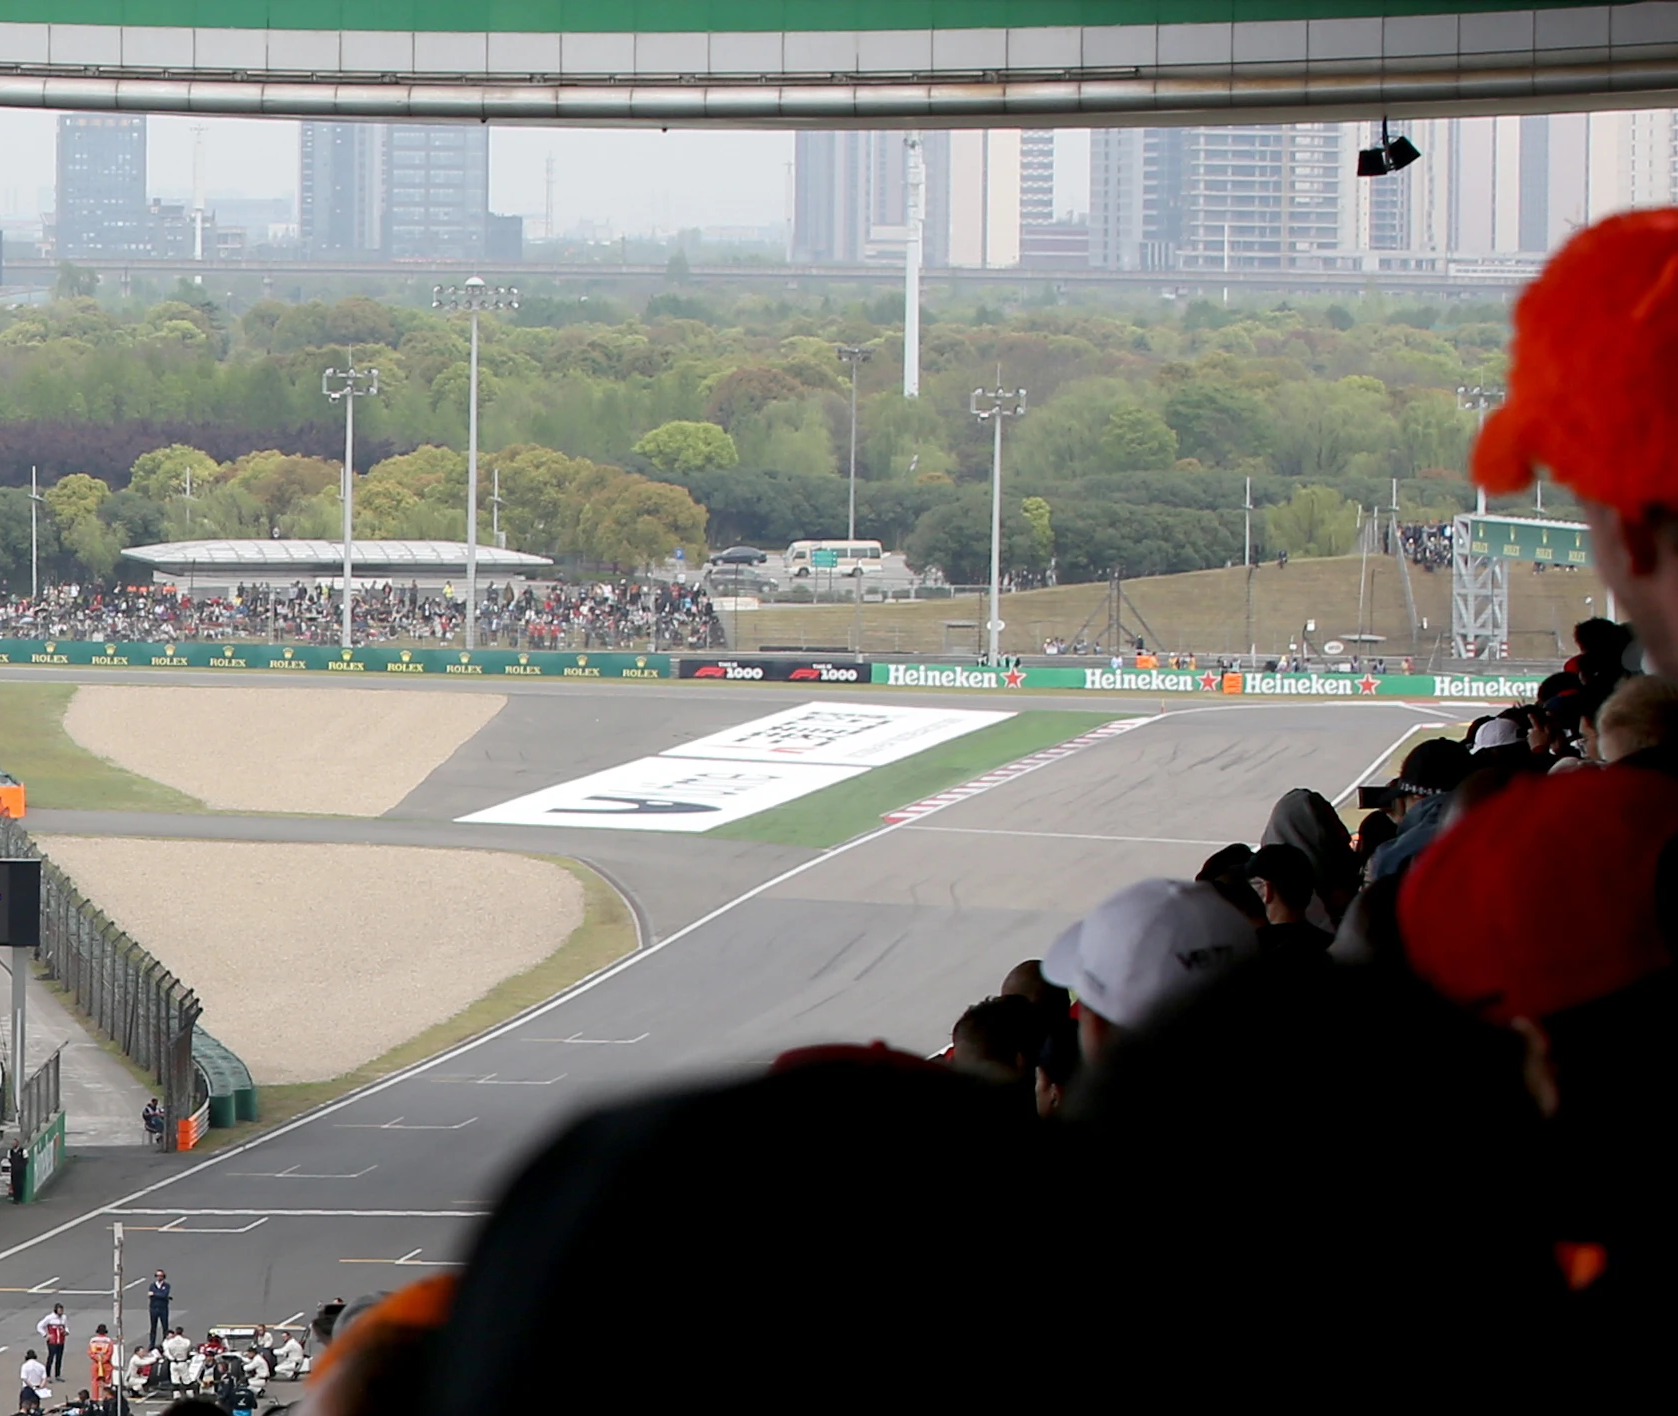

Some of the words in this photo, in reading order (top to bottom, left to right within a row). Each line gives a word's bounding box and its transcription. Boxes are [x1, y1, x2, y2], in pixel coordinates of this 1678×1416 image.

[31, 654, 68, 663] ROLEX
[92, 656, 128, 665] ROLEX
[151, 656, 188, 666] ROLEX
[209, 658, 246, 667] ROLEX
[269, 660, 306, 669] ROLEX
[328, 661, 365, 671] ROLEX
[387, 663, 424, 673] ROLEX
[446, 664, 482, 674] ROLEX
[505, 666, 541, 675] ROLEX
[564, 667, 600, 676] ROLEX
[622, 669, 659, 678] ROLEX
[726, 667, 763, 680] 1000
[821, 669, 857, 681] 1000
[887, 664, 997, 688] Heineken
[1084, 668, 1193, 691] Heineken
[1244, 672, 1353, 695] Heineken
